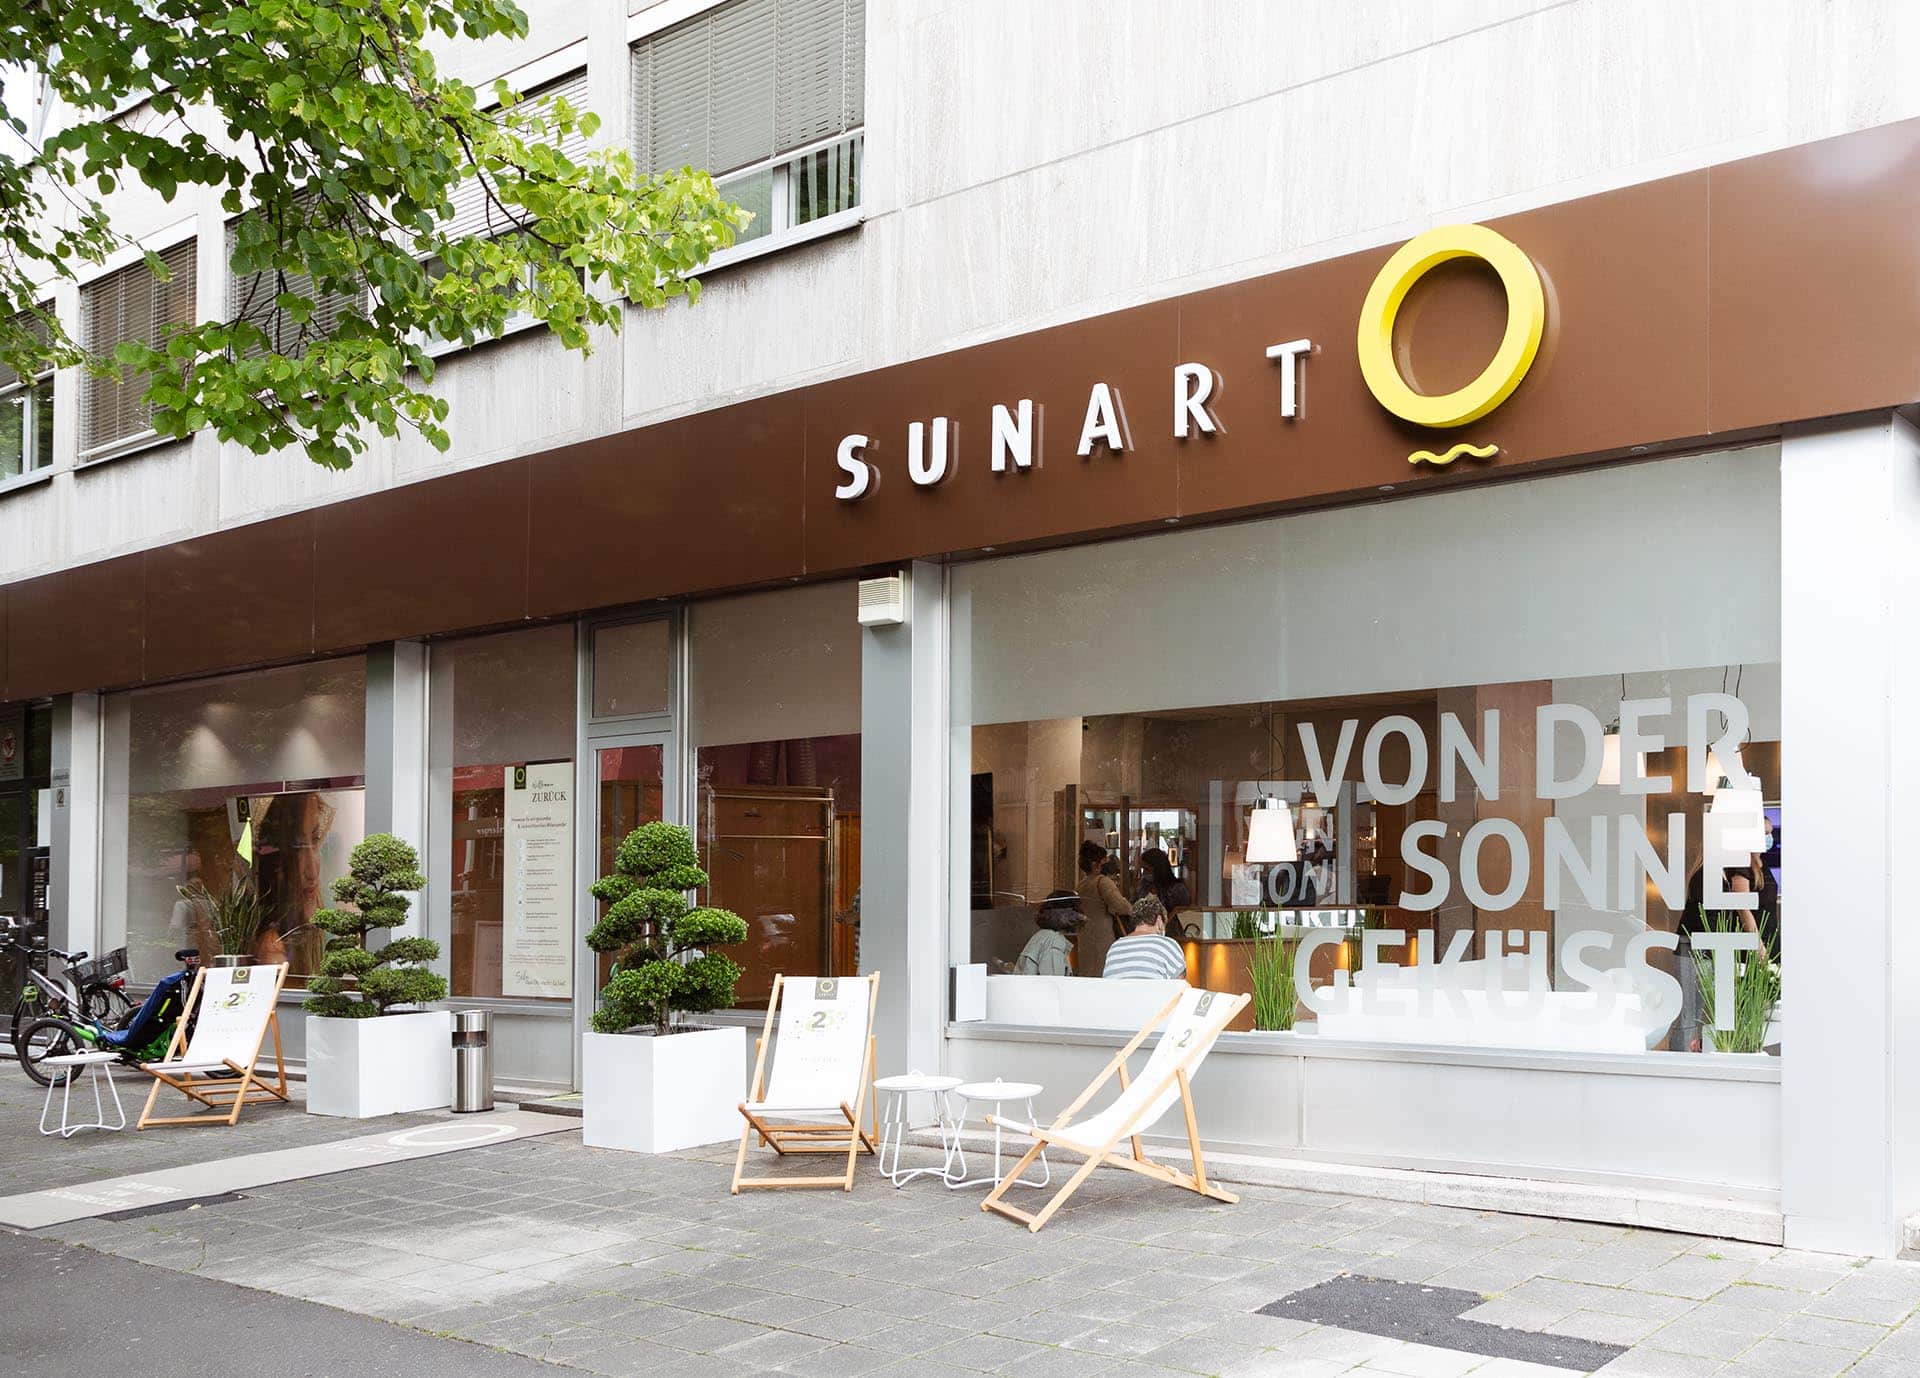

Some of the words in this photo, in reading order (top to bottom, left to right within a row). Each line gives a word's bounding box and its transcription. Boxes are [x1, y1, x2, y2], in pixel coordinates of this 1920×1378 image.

[531, 790, 567, 803] ZURÜCK
[1297, 708, 1500, 807] VON
[1535, 692, 1753, 799] DER
[1398, 812, 1760, 912] SONNE
[1294, 929, 1760, 1032] GEKÜSST
